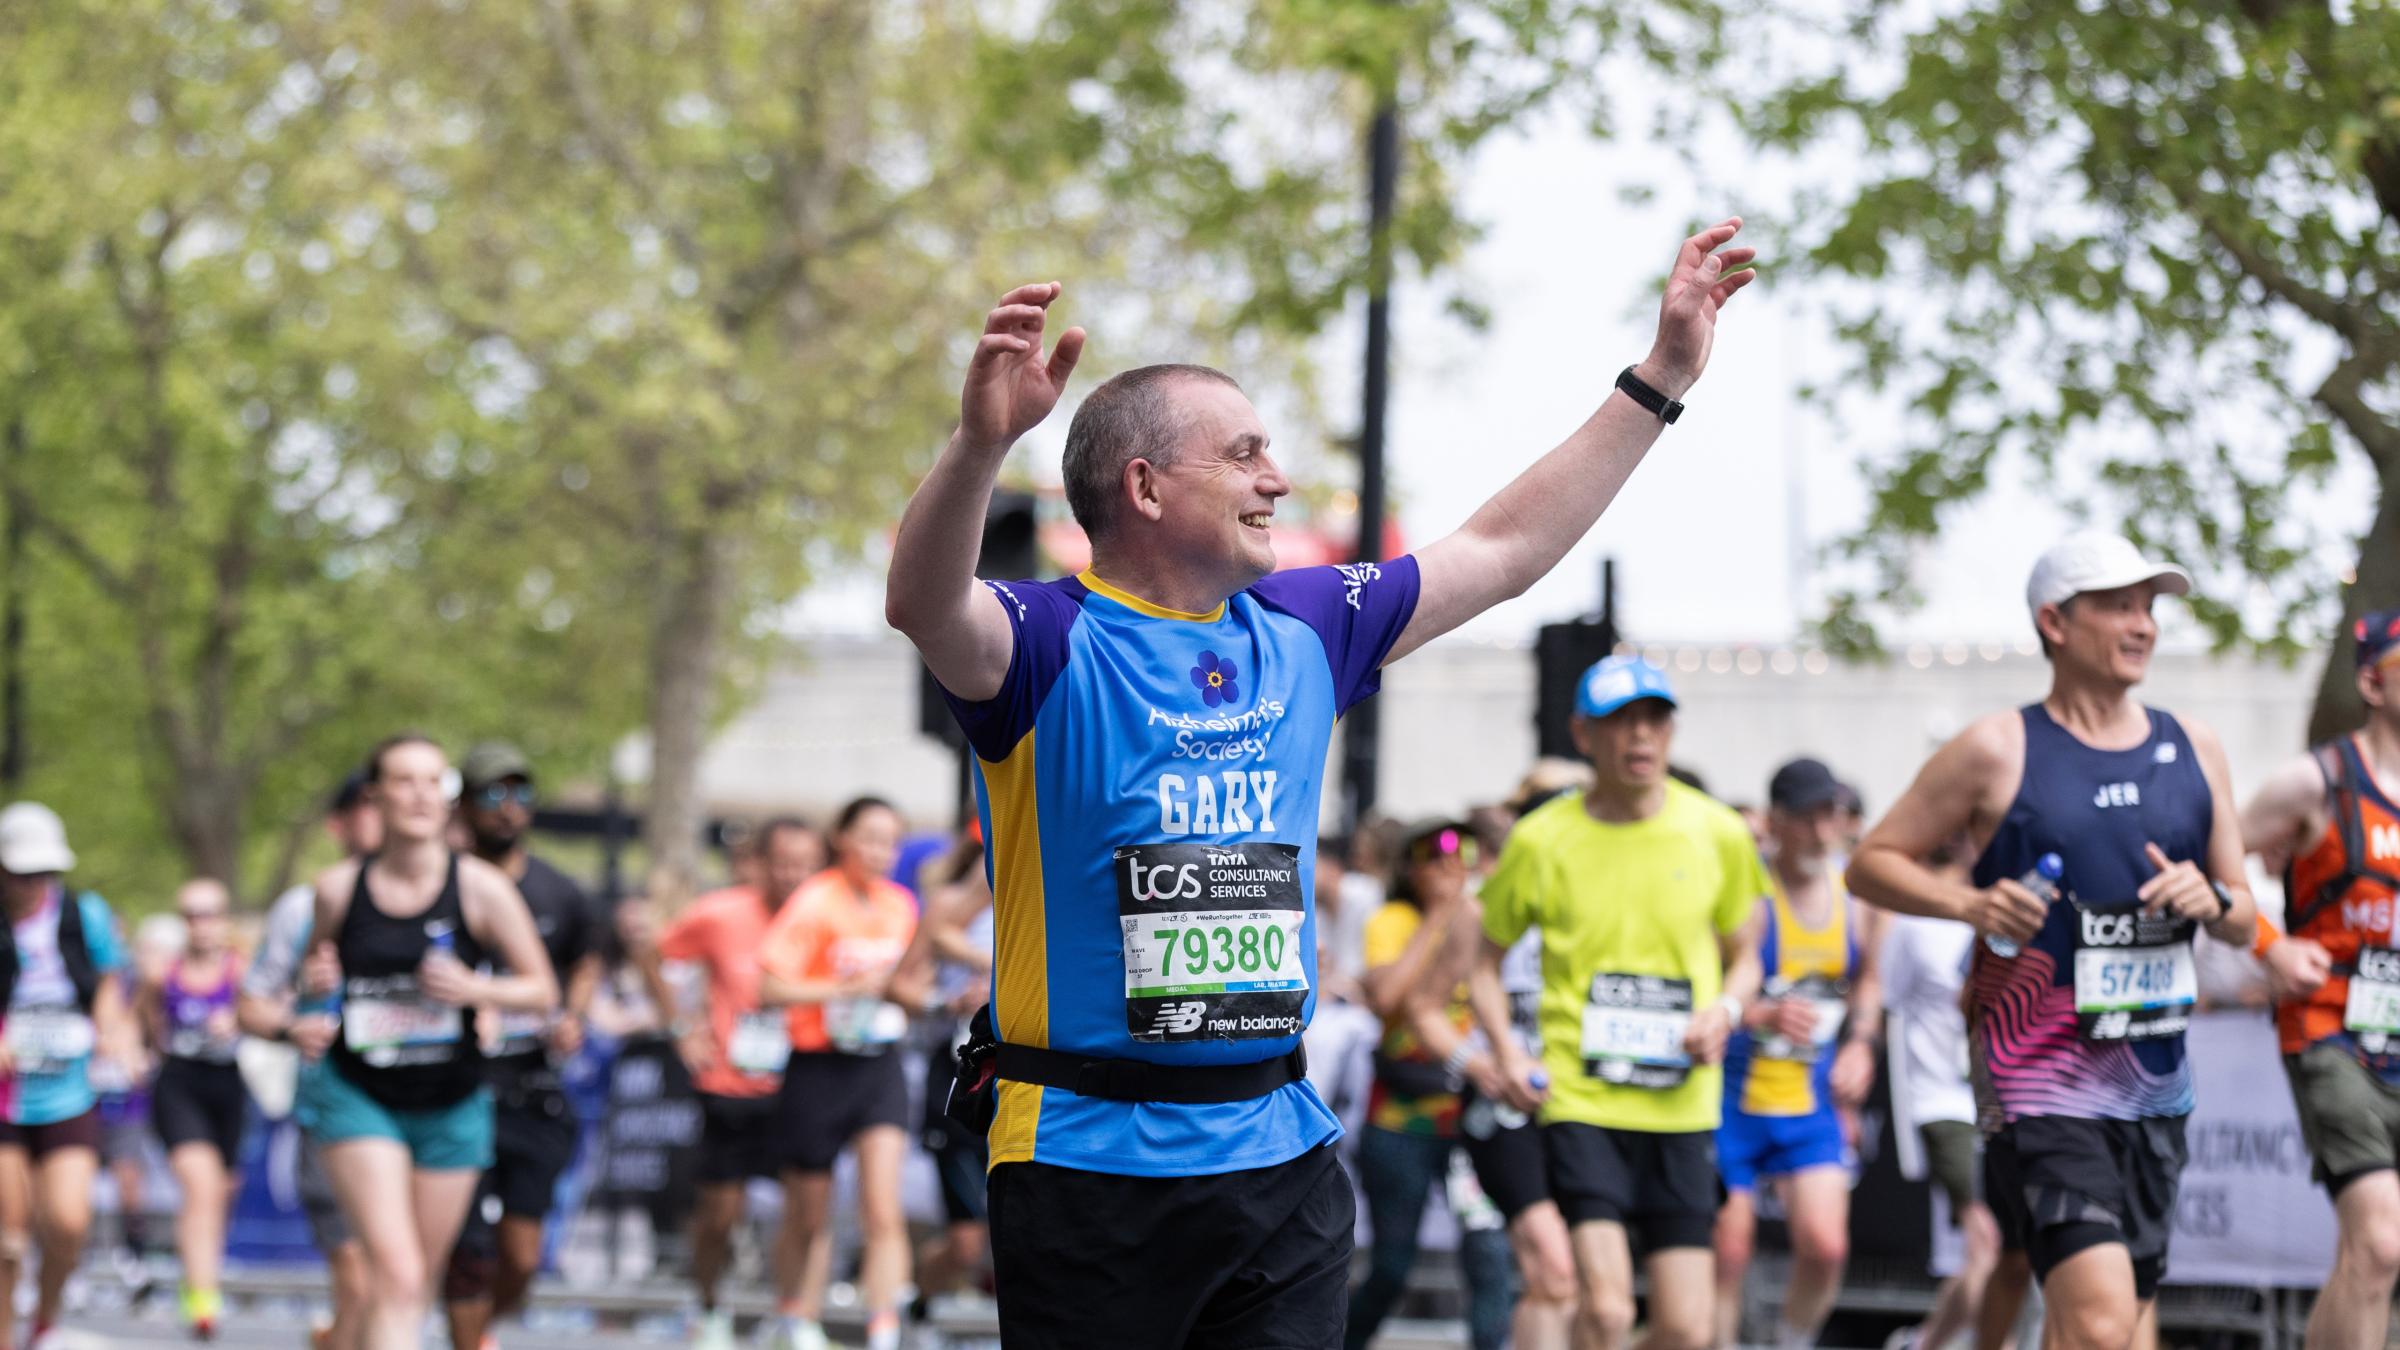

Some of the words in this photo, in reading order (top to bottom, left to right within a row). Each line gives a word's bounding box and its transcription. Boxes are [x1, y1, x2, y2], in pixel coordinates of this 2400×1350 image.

[1172, 729, 1271, 762] Society
[1158, 770, 1277, 835] GARY
[2093, 781, 2140, 808] JER
[1207, 853, 1248, 866] TATA
[1129, 857, 1202, 901] tcs
[1209, 869, 1291, 883] CONSULTANCY
[1210, 885, 1267, 898] SERVICES
[1196, 914, 1243, 922] #WeRunTogether
[2082, 909, 2135, 945] tcs
[1154, 924, 1285, 977] 79380
[1208, 1019, 1238, 1031] new
[1241, 1015, 1296, 1031] balance
